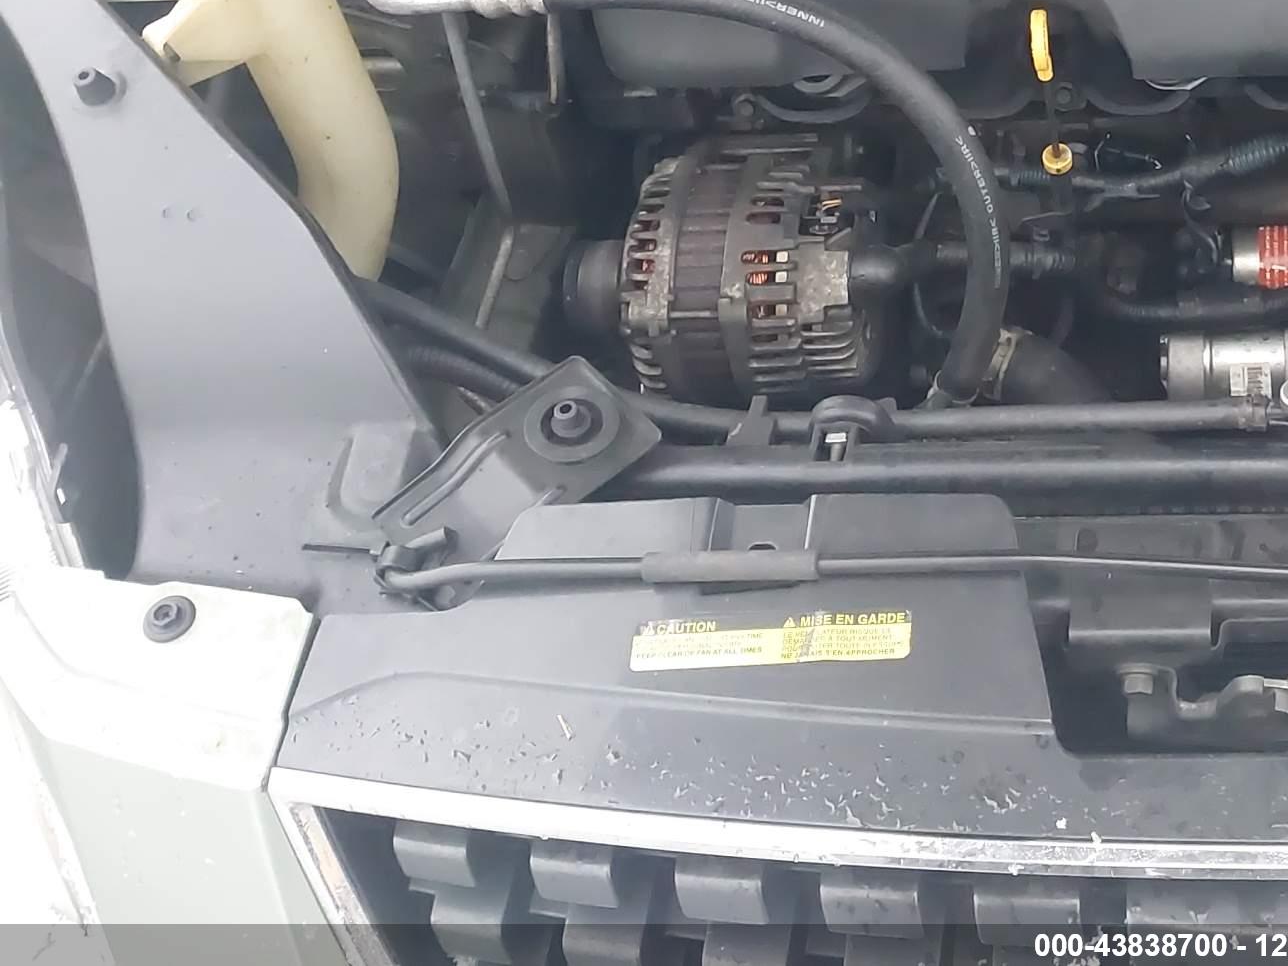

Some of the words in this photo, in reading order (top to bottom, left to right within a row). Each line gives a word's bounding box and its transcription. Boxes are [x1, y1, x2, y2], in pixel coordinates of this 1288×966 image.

[800, 614, 832, 627] MISE
[835, 613, 854, 625] EN
[857, 612, 906, 625] GARDE
[656, 621, 717, 635] CAUTION
